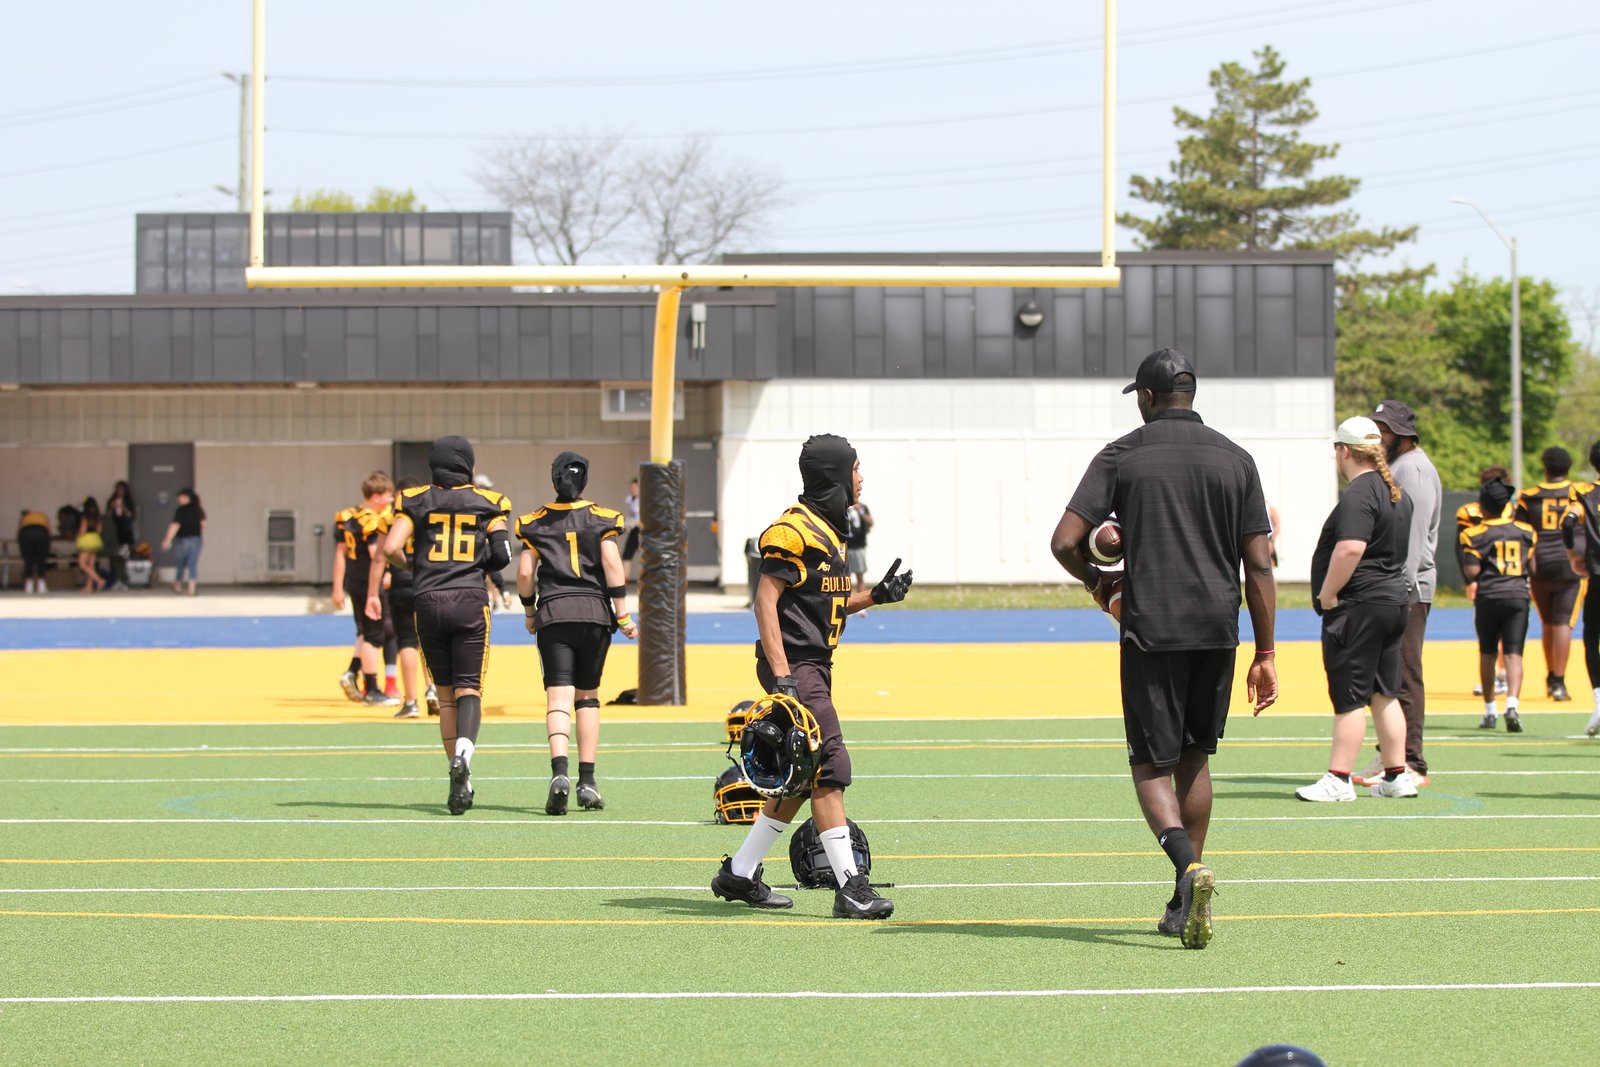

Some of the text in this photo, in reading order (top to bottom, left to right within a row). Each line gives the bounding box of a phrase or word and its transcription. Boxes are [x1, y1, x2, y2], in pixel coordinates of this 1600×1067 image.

[428, 513, 477, 562] 36
[565, 532, 581, 578] 1
[1494, 540, 1522, 577] 19
